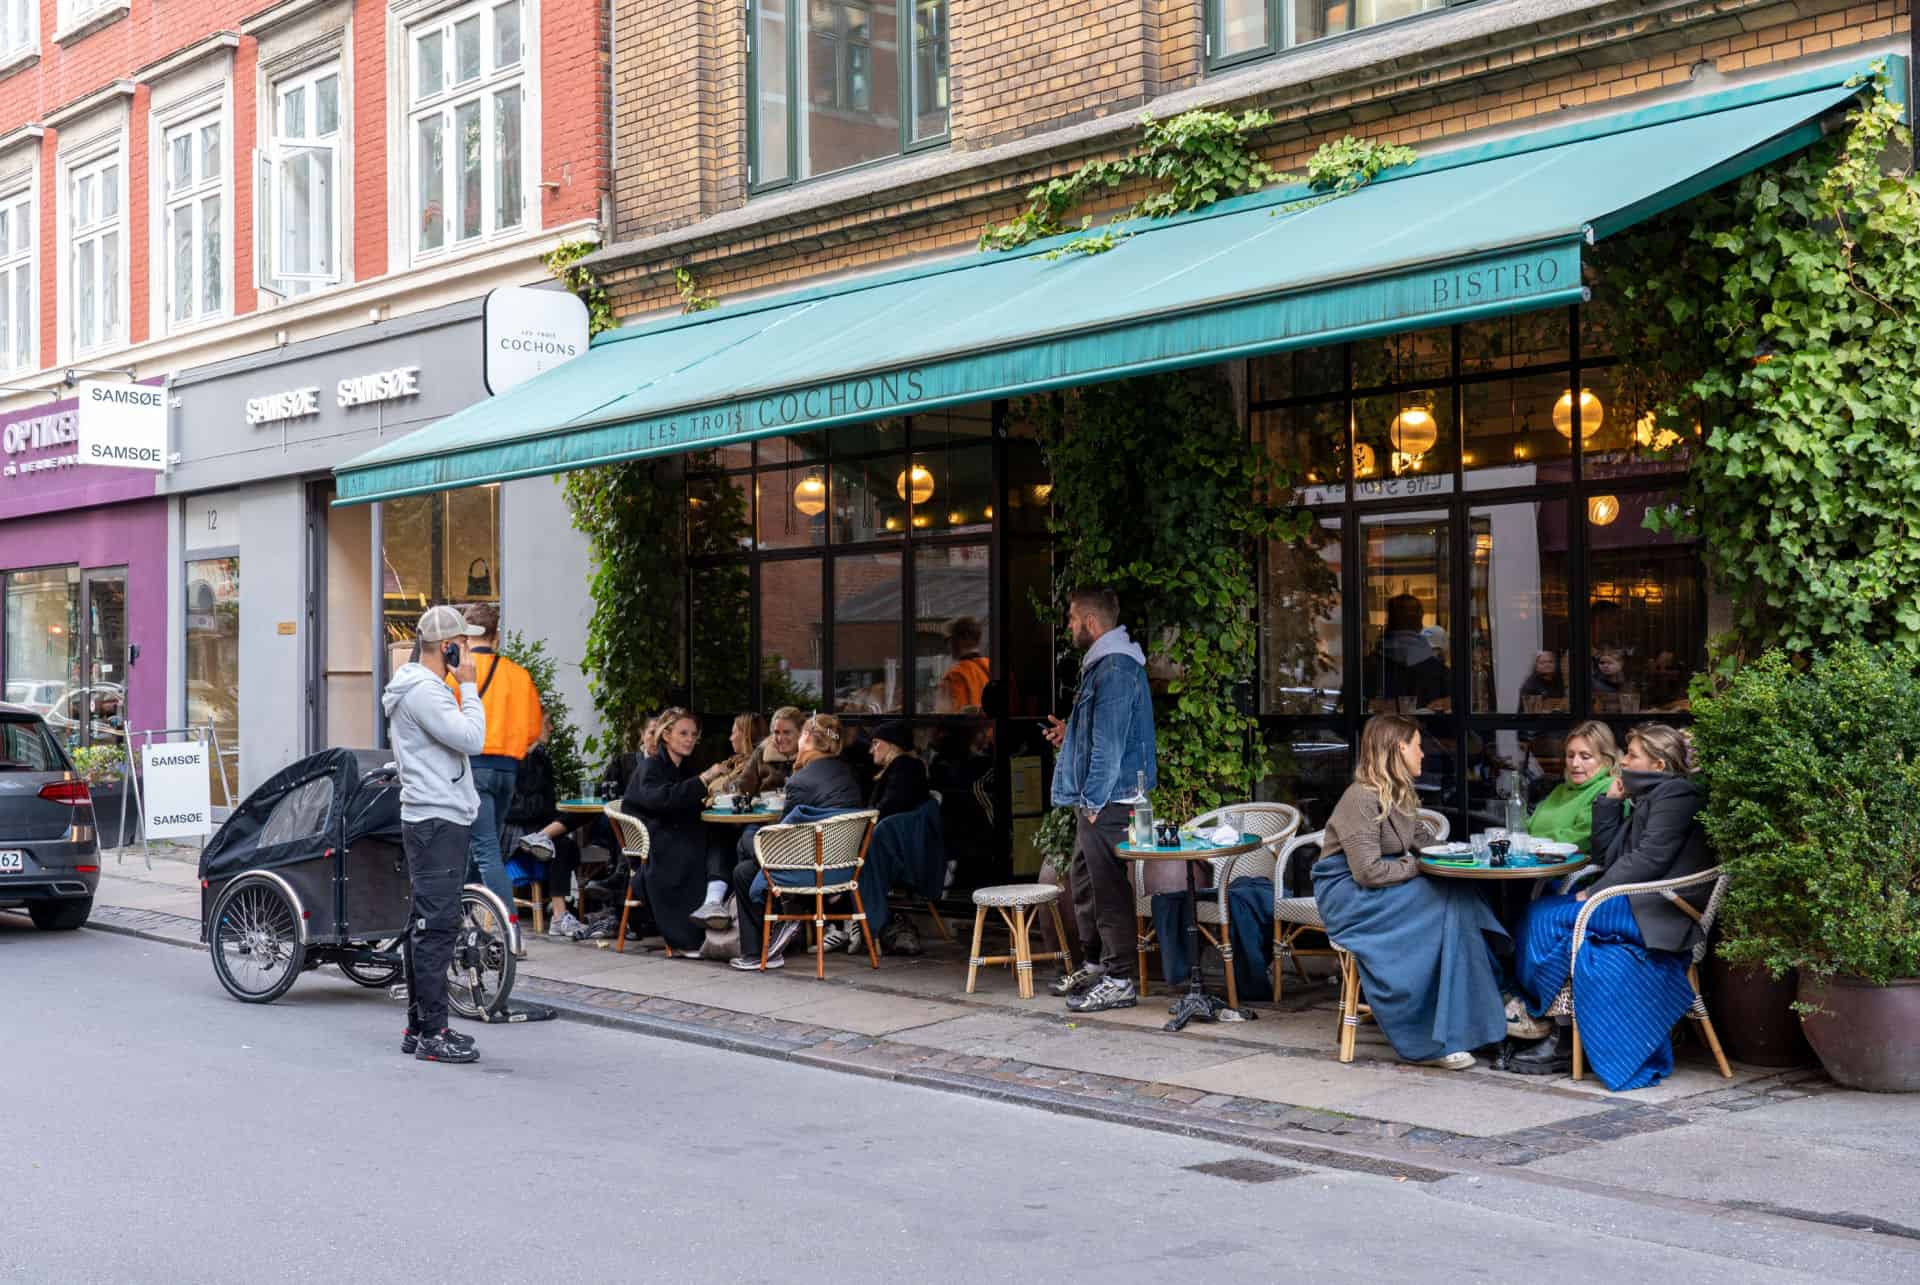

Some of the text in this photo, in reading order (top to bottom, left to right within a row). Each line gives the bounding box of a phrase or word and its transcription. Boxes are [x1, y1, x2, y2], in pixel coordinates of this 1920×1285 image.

[1433, 258, 1558, 303] BISTRO
[500, 338, 576, 356] COCHONS
[92, 388, 161, 406] SAMSØE
[246, 366, 420, 424] SAMSØE SAMSØE
[649, 370, 923, 440] LES TROIS COCHONS
[91, 444, 161, 462] SAMSØE
[208, 510, 217, 530] 12
[151, 754, 201, 767] SAMSØE
[153, 812, 203, 826] SAMSØE
[1, 853, 19, 867] 62
